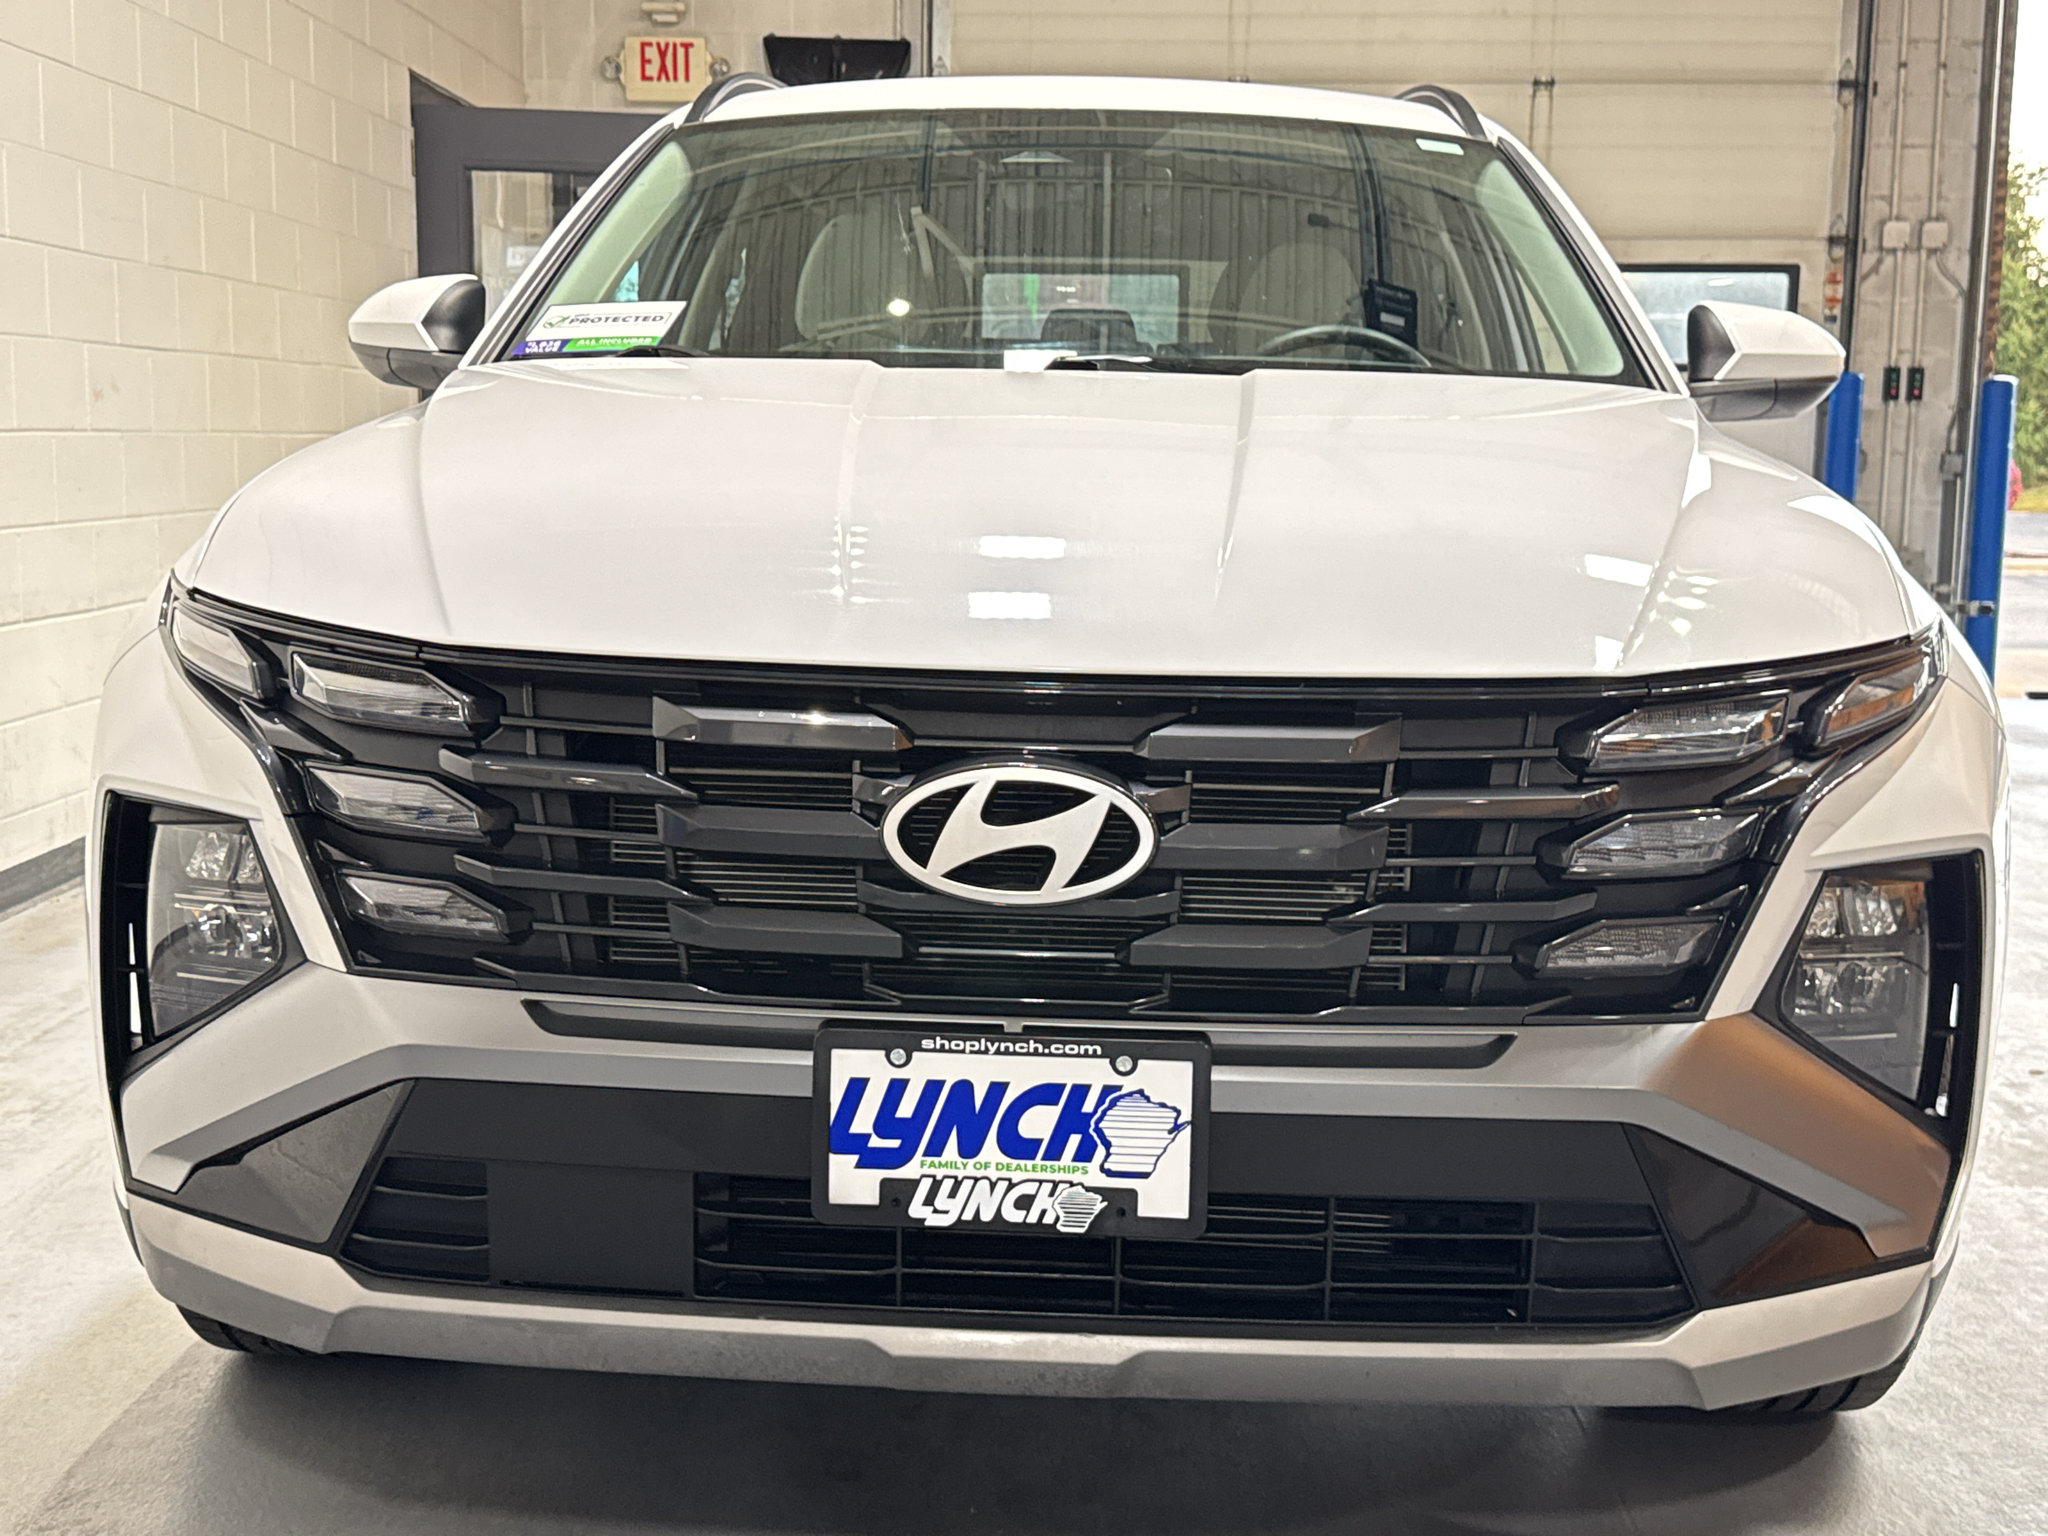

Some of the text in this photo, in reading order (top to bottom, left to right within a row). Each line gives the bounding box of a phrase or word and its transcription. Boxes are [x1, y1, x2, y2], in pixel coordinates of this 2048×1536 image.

[639, 41, 695, 83] EXIT
[568, 314, 665, 325] PROTECTED
[920, 1036, 1102, 1056] shoplynch.com
[829, 1076, 1124, 1170] LYNCH
[919, 1159, 1089, 1175] FAMILY OF DEALERSHIPS
[908, 1175, 1068, 1227] LYNCH
